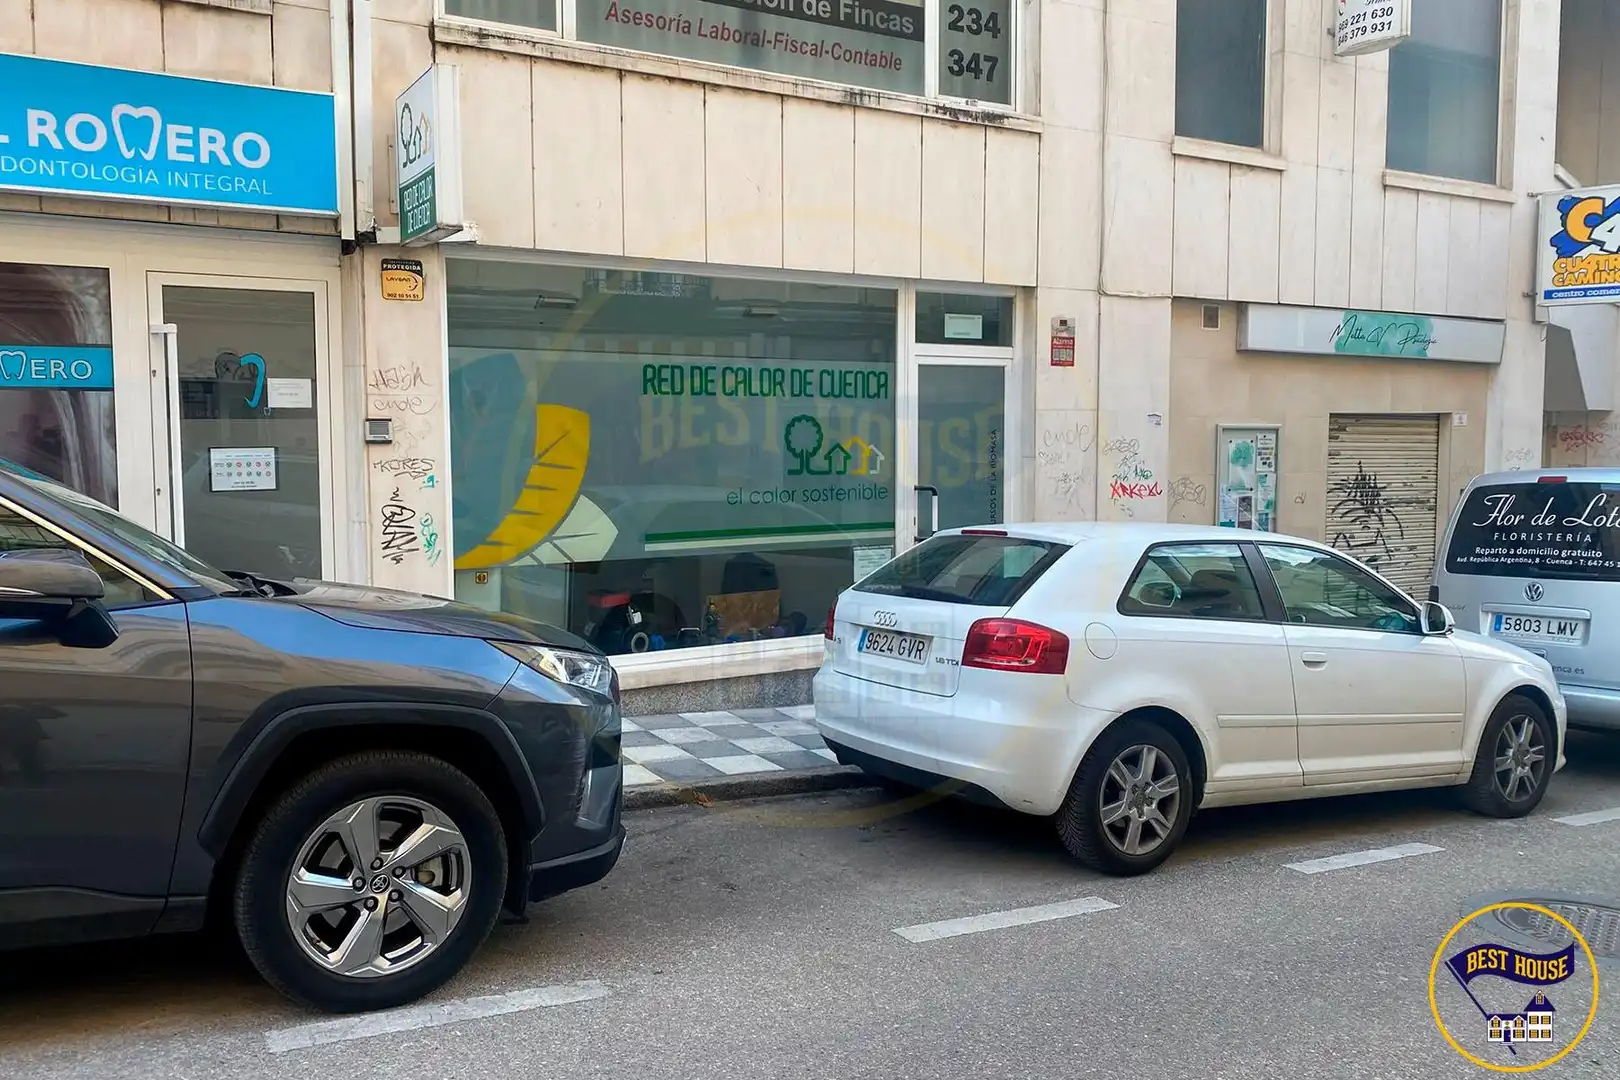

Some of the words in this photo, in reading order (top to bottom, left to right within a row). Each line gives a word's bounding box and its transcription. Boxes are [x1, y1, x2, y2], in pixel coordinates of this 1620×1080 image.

[840, 6, 914, 35] Fincas
[947, 4, 1002, 40] 234
[1350, 11, 1367, 26] 221
[1371, 6, 1394, 20] 630
[605, 1, 692, 36] Asesoría
[697, 17, 903, 72] Laboral-Fiscal-Contable
[1350, 25, 1367, 40] 379
[1370, 20, 1393, 34] 931
[947, 48, 999, 83] 347
[167, 171, 273, 196] INTEGRAL
[1552, 290, 1584, 298] centro
[642, 364, 685, 396] RED
[690, 366, 717, 397] DE
[722, 366, 786, 398] CALOR
[791, 368, 814, 398] DE
[819, 369, 889, 400] CUENCA
[726, 487, 743, 506] el
[749, 486, 797, 505] calor
[802, 484, 889, 503] sostenible
[1472, 494, 1524, 527] Flor
[1531, 497, 1557, 526] de
[1493, 532, 1592, 543] FLORISTERÍA
[1475, 546, 1508, 556] Reparto
[1516, 546, 1560, 556] domicilio
[1561, 548, 1603, 558] gratuito
[1546, 557, 1573, 565] Cuenca
[1504, 617, 1542, 633] 5803
[1547, 622, 1579, 636] LMV
[865, 632, 895, 655] 9624
[897, 637, 926, 660] GVR
